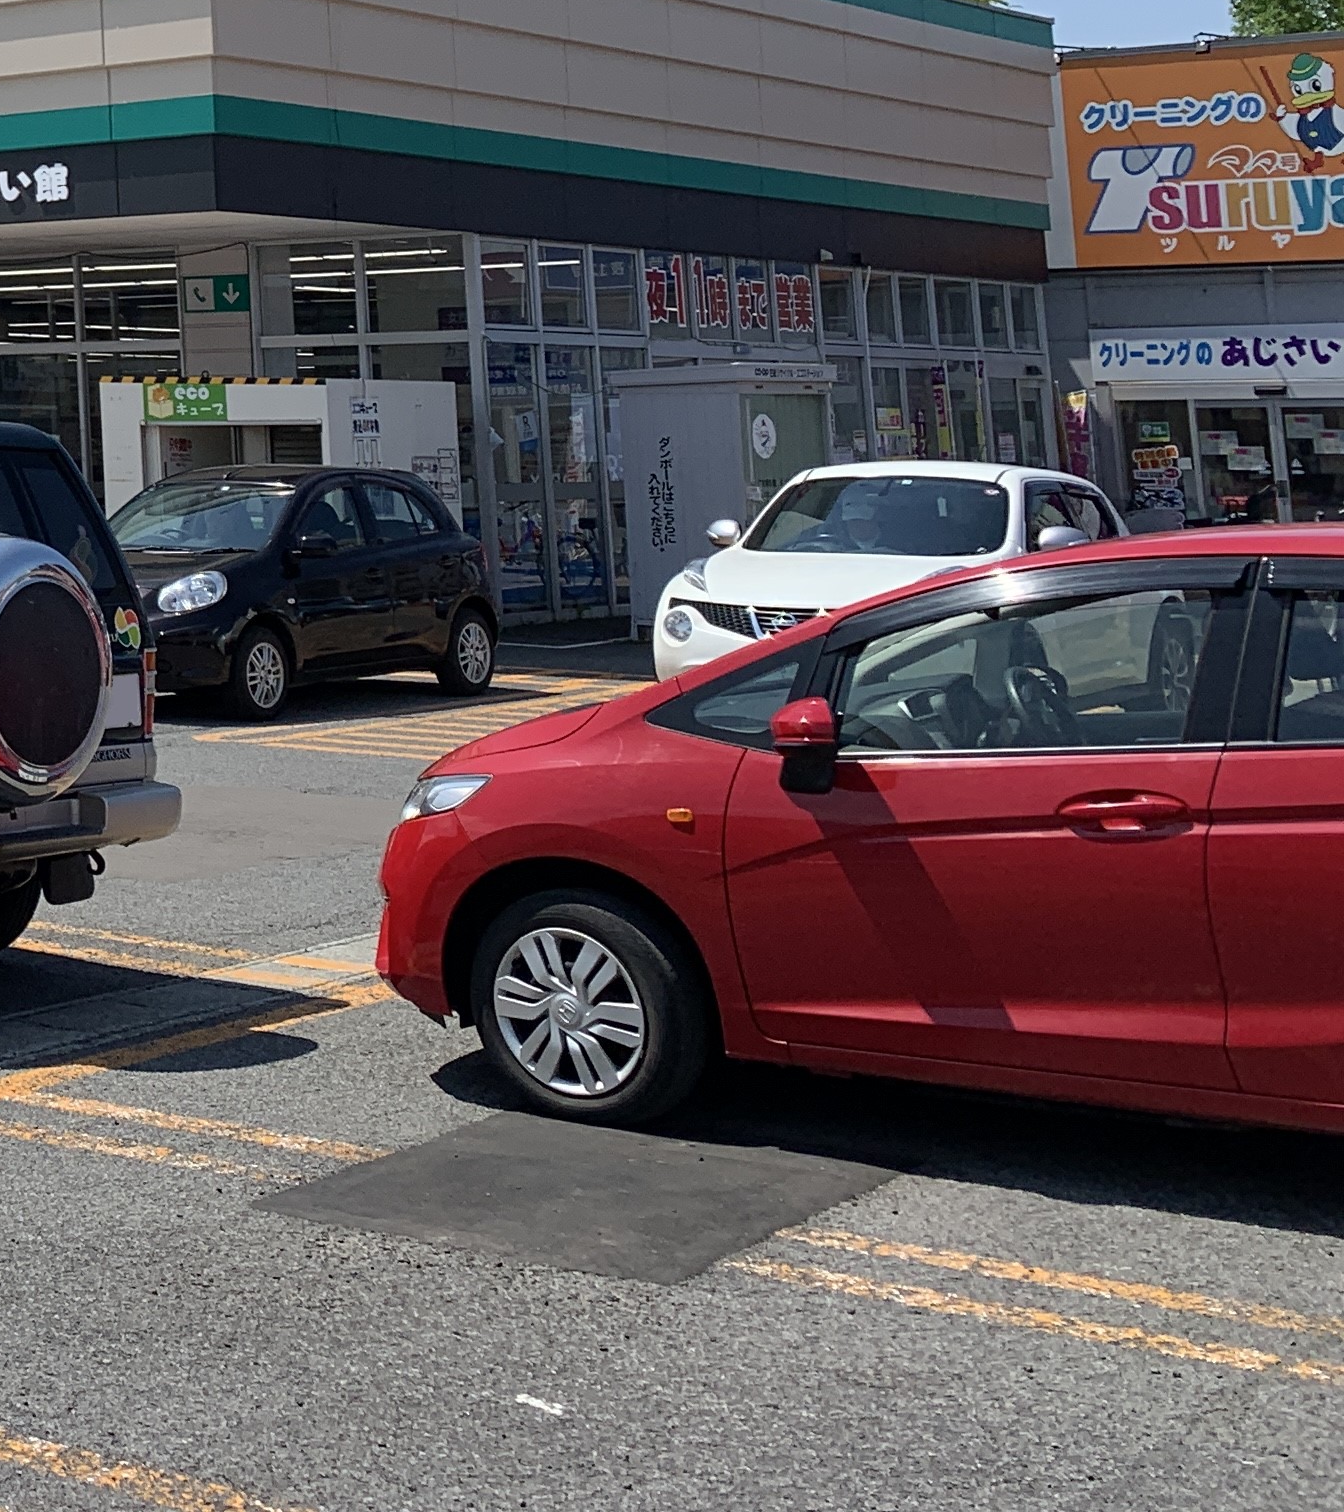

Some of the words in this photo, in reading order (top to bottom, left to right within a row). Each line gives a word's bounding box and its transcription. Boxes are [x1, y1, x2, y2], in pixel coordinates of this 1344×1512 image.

[1081, 91, 1266, 133] クリーニングの
